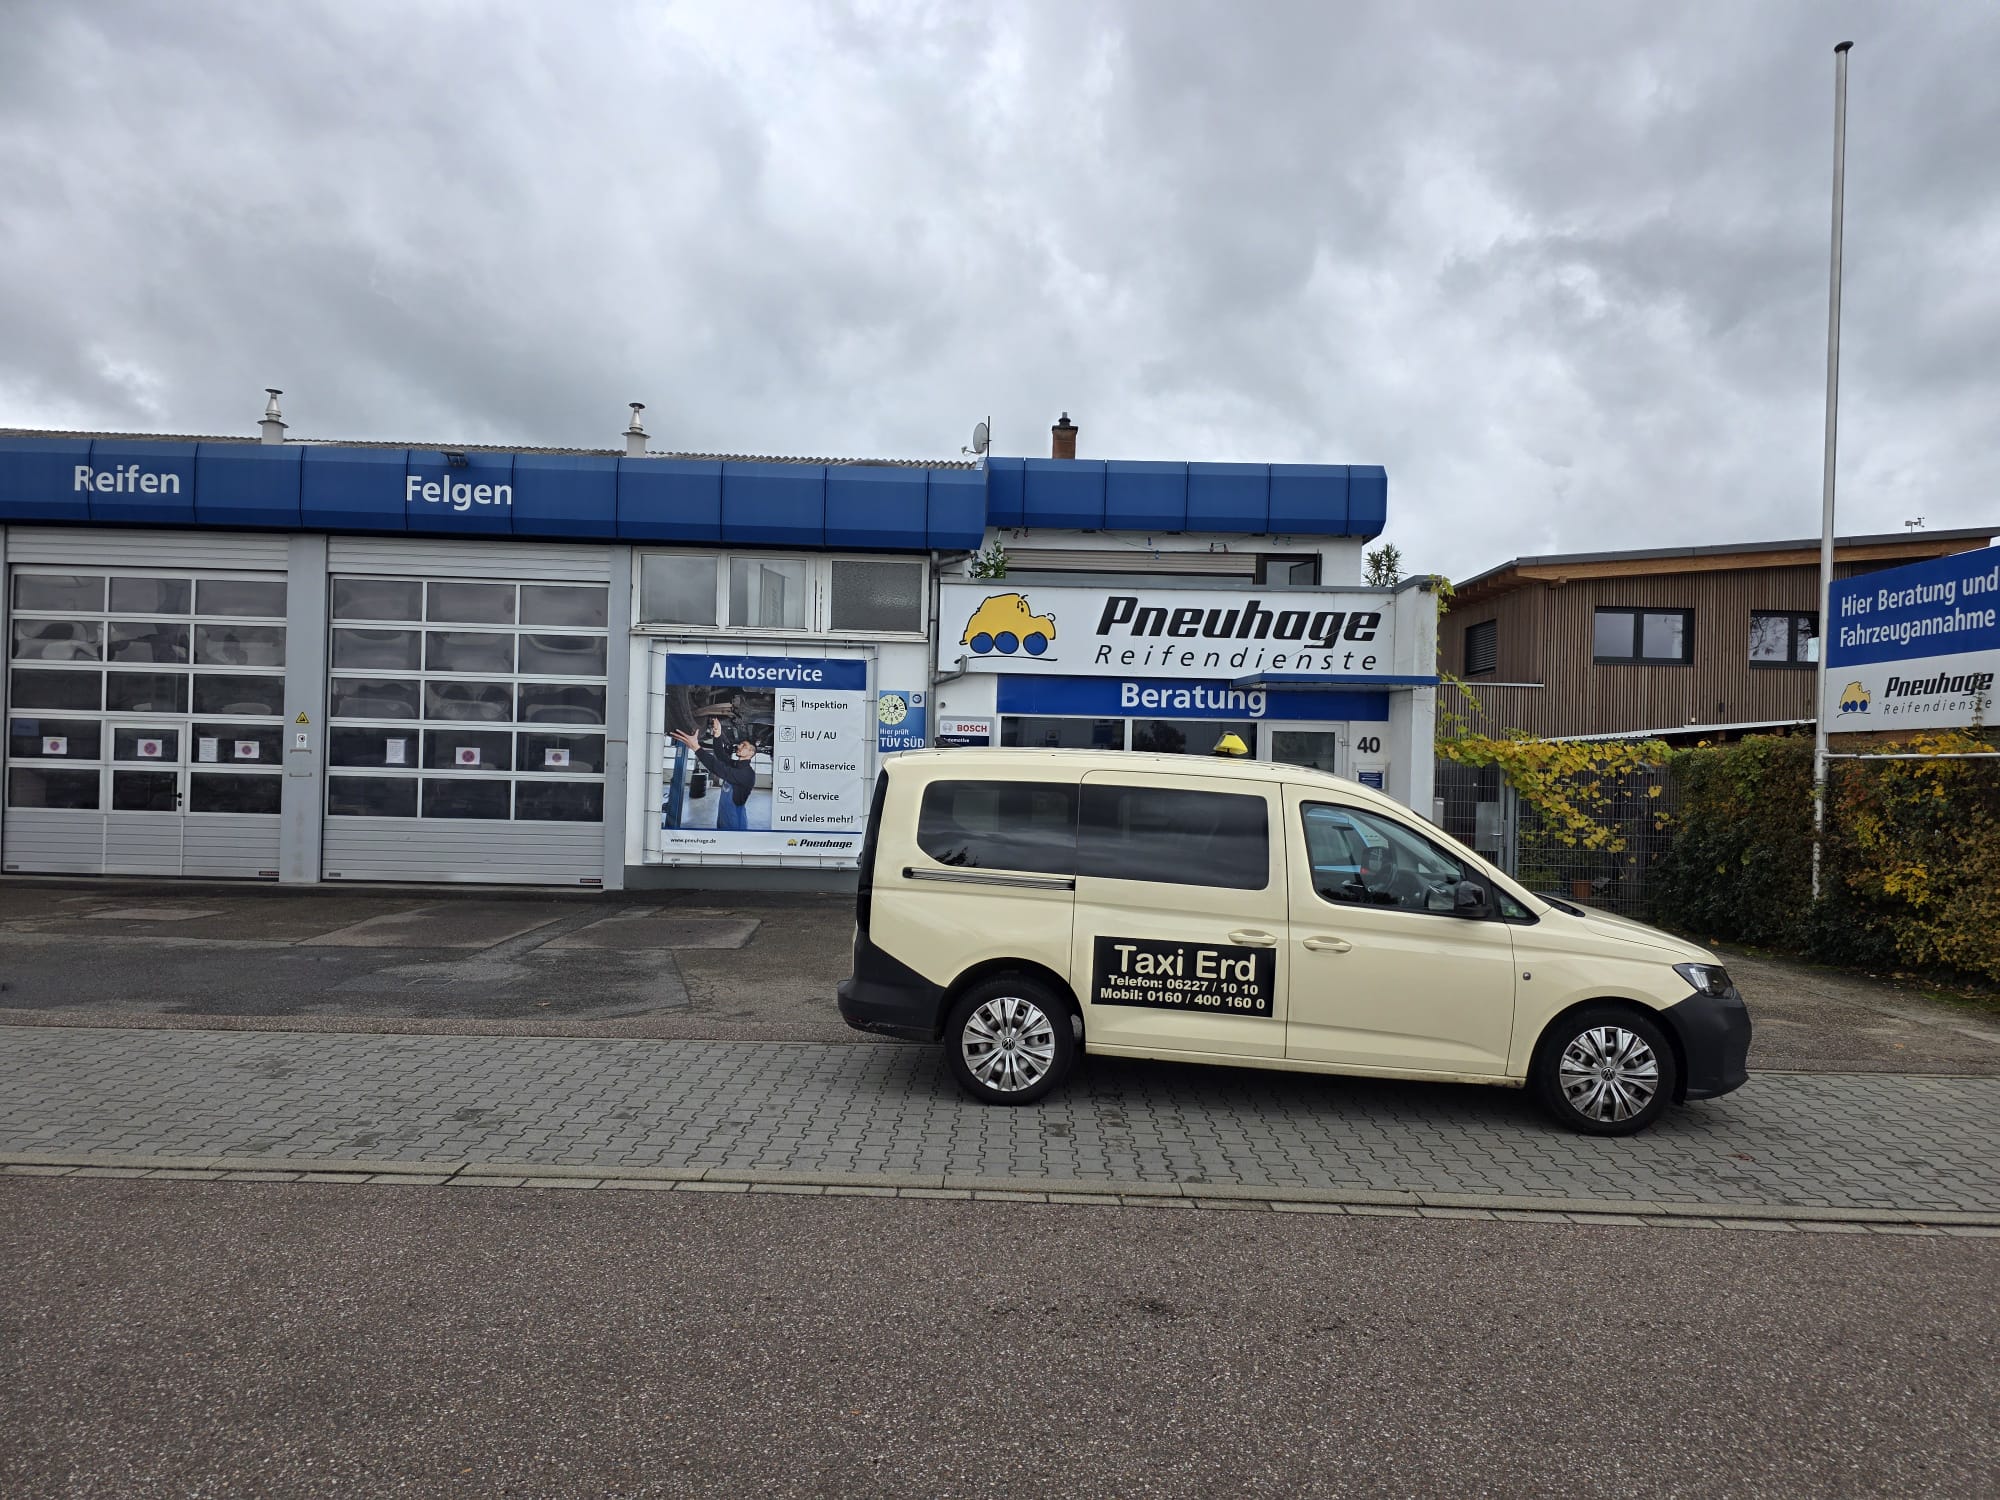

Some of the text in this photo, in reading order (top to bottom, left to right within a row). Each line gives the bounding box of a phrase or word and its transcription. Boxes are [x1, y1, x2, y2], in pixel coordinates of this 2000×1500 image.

[73, 464, 181, 494] Reifen
[405, 475, 514, 511] Felgen
[1841, 565, 2000, 617] Hier Beratung und
[1096, 595, 1382, 650] Pneuhage
[1839, 607, 1996, 648] Fahrzeugannahme
[1095, 644, 1378, 671] Reifendienste
[709, 662, 823, 682] Autoservice
[1884, 672, 1994, 698] Pneuhage
[801, 700, 848, 710] Inspektion
[1121, 682, 1268, 717] Beratung
[1883, 699, 1992, 715] Reifendiense
[800, 730, 837, 740] HU / AU
[894, 728, 909, 736] prüft
[956, 724, 987, 732] BOSCH
[879, 735, 925, 748] TÜV SÜD
[1357, 736, 1381, 753] 40
[799, 761, 856, 771] Klimaservice
[798, 790, 840, 801] Ölservice
[780, 813, 854, 823] und vieles mehr!
[799, 838, 853, 849] Pneuhage
[1114, 944, 1257, 983] Taxi Erd
[1108, 974, 1259, 995] Telefon: 06227 / 10 10
[1100, 987, 1266, 1010] Mobil: 0160 / 400 160 0
